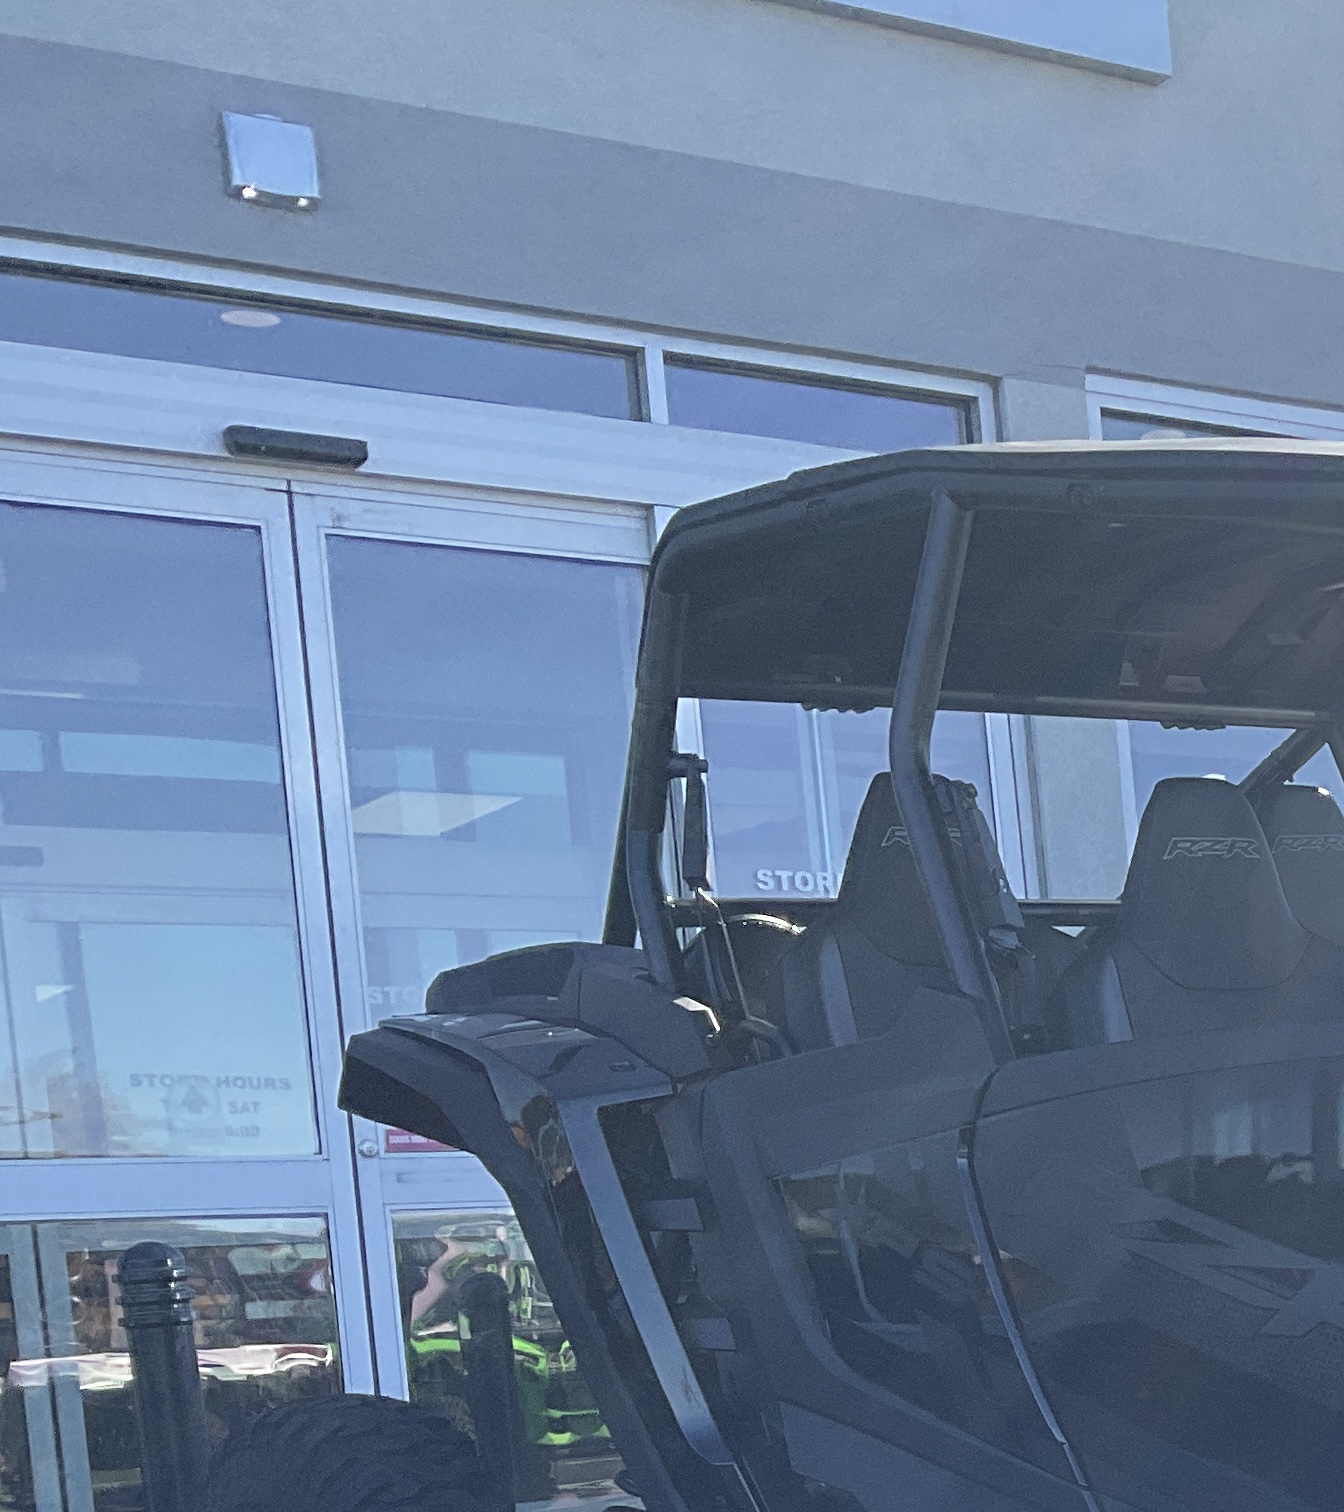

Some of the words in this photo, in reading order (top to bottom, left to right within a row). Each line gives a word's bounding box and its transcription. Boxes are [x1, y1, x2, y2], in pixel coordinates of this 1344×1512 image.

[880, 826, 964, 847] RR
[1163, 836, 1261, 861] RZR
[215, 1075, 293, 1091] HOURS
[227, 1100, 262, 1115] SAT
